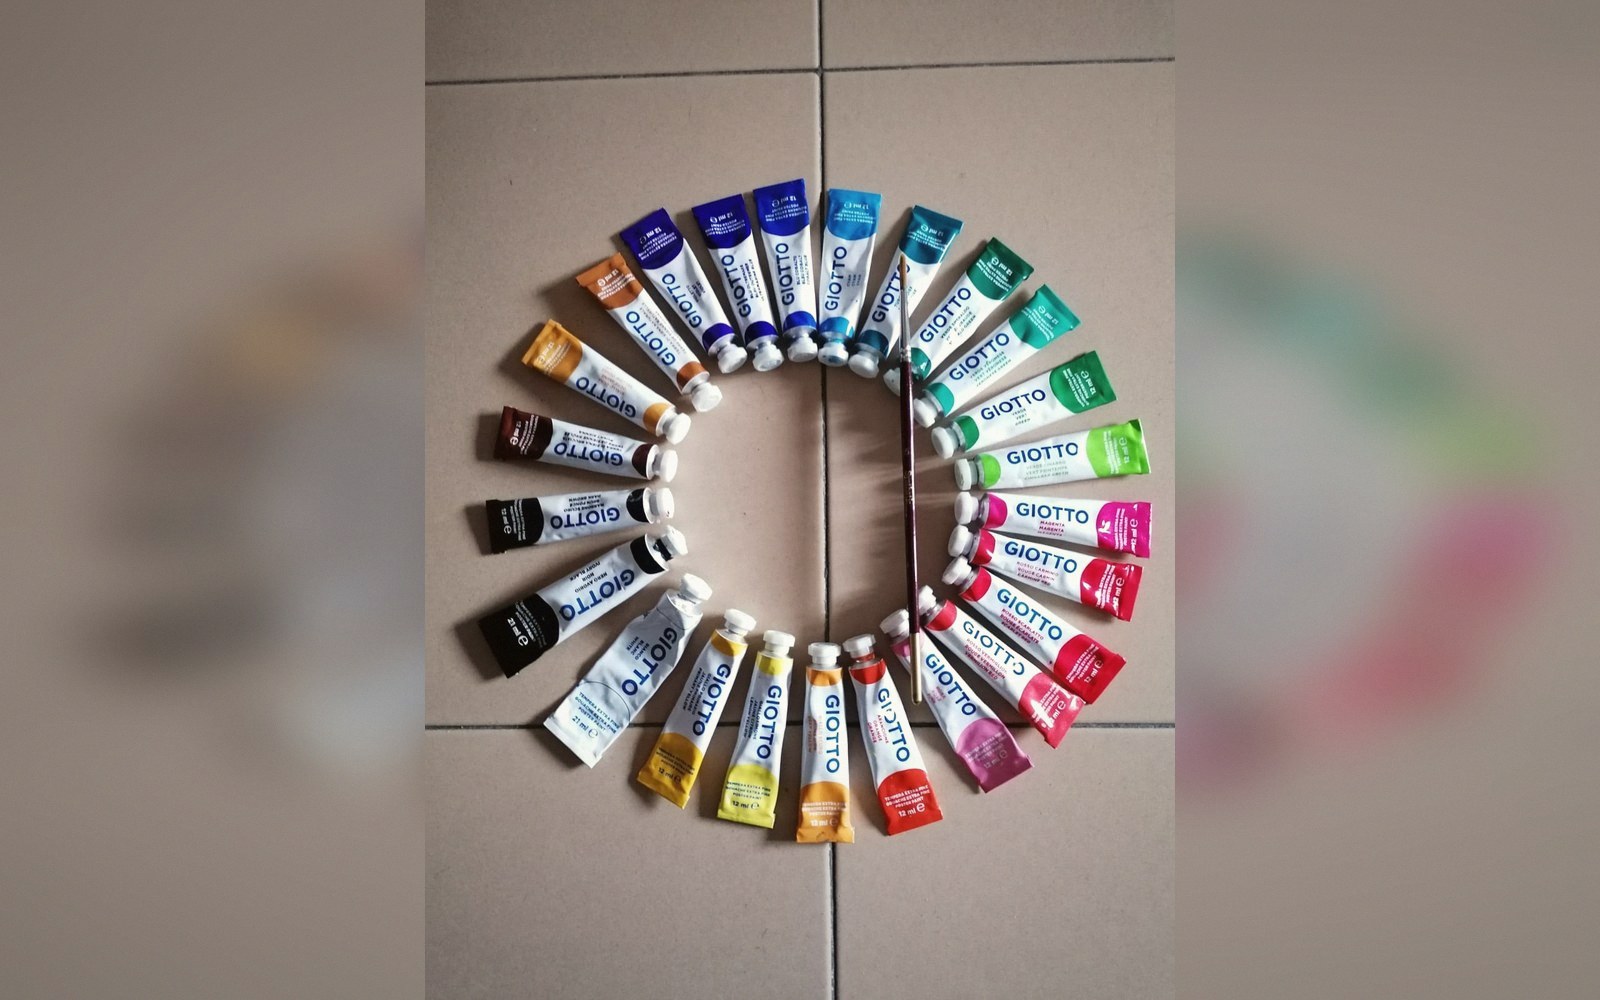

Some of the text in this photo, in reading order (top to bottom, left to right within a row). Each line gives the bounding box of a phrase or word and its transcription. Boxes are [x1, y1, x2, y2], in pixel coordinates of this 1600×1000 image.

[645, 226, 661, 238] 12 ml
[773, 242, 796, 306] GIOTTO
[824, 245, 847, 311] GIOTTO
[997, 262, 1013, 276] 12 ml
[720, 252, 752, 319] GIOTTO
[659, 270, 704, 329] GIOTTO
[917, 283, 973, 345] GIOTTO
[1043, 310, 1059, 325] 12 ml
[622, 308, 678, 367] GIOTTO
[947, 329, 1011, 383] GIOTTO
[1085, 377, 1094, 387] ml
[1089, 386, 1097, 395] 12
[573, 373, 638, 421] GIOTTO
[978, 385, 1046, 423] GIOTTO
[552, 441, 624, 466] GIOTTO
[1005, 440, 1079, 465] GIOTTO
[1121, 446, 1129, 463] 12 ml
[500, 507, 507, 515] 12
[502, 516, 509, 525] ml
[548, 507, 620, 530] GIOTTO
[1014, 501, 1089, 524] GIOTTO
[1039, 519, 1064, 527] MAGENTA
[1131, 527, 1137, 536] ml
[1130, 536, 1136, 544] 12
[1003, 539, 1078, 574] GIOTTO
[1016, 560, 1034, 570] ROSSO
[568, 560, 600, 582] IVORY BLACK
[557, 566, 637, 623] GIOTTO
[1114, 586, 1122, 596] ml
[507, 616, 516, 626] 21
[994, 586, 1064, 642] GIOTTO
[1001, 608, 1018, 622] ROSSO
[511, 624, 521, 636] ml
[625, 635, 638, 651] WHITE
[629, 639, 644, 655] BLANC
[633, 642, 649, 661] BIANCO
[960, 617, 1027, 678] GIOTTO
[618, 625, 682, 699] GIOTTO
[700, 672, 711, 691] GIALLO
[922, 650, 978, 718] GIOTTO
[1083, 667, 1098, 684] 12 ml
[577, 691, 620, 729] TEMPERA EXTRA FINE
[689, 661, 732, 738] GIOTTO
[571, 714, 581, 724] 21
[578, 721, 589, 731] ml
[577, 706, 607, 732] POSTER PAINT
[591, 712, 607, 726] EXTRA
[605, 723, 617, 734] FINE
[755, 684, 782, 759] GIOTTO
[875, 686, 911, 763] GIOTTO
[825, 694, 839, 772] GIOTTO
[866, 721, 876, 743] ORANGE
[872, 720, 882, 741] ORANGE
[897, 809, 906, 817] 12
[906, 807, 917, 816] ml
